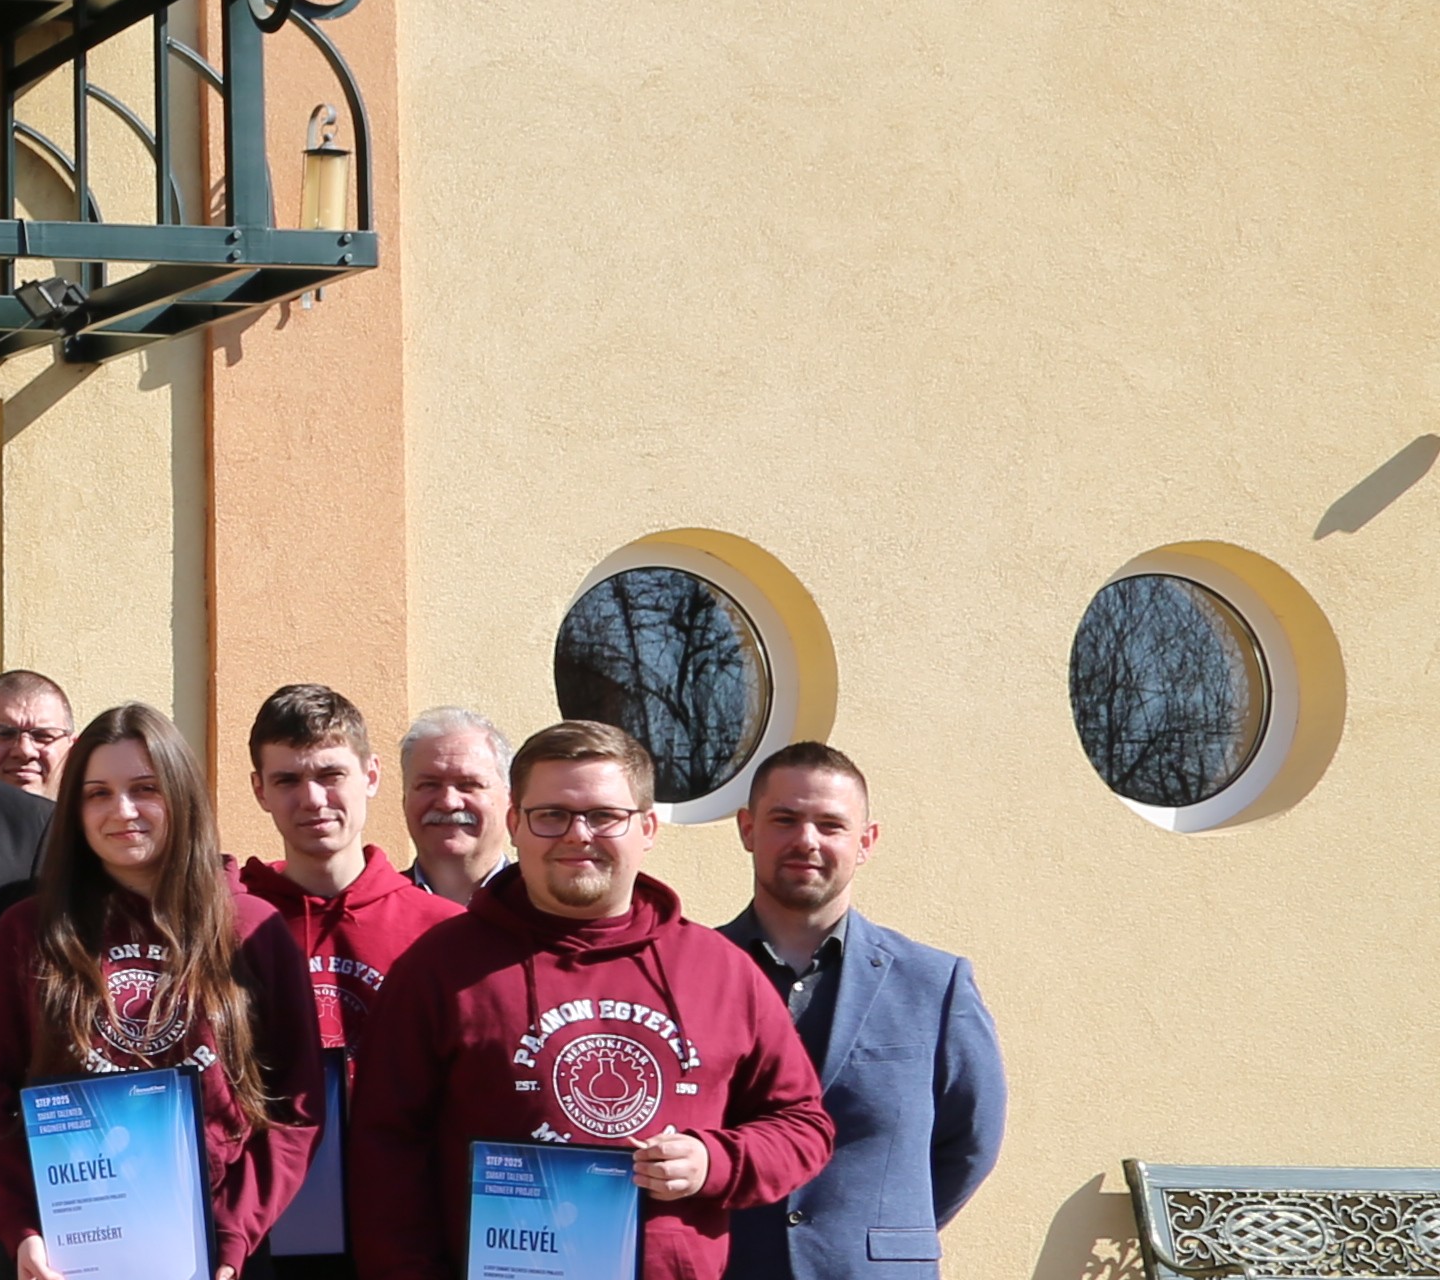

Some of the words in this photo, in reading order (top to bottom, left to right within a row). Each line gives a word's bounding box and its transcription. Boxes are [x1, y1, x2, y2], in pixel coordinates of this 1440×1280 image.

[563, 1037, 621, 1064] MÉRNÖKI
[624, 1041, 650, 1066] KAR
[515, 1081, 541, 1091] EST.
[35, 1096, 51, 1108] STEP
[52, 1095, 70, 1105] 2025
[562, 1094, 605, 1133] PANNON
[607, 1096, 656, 1134] EGYETEM
[48, 1153, 117, 1185] OKLEVÉL
[486, 1156, 503, 1166] STEP
[504, 1157, 523, 1168] 2025
[57, 1234, 66, 1246] I.
[66, 1226, 123, 1245] HELYEZÉSÉRT
[486, 1226, 558, 1253] OKLEVÉL
